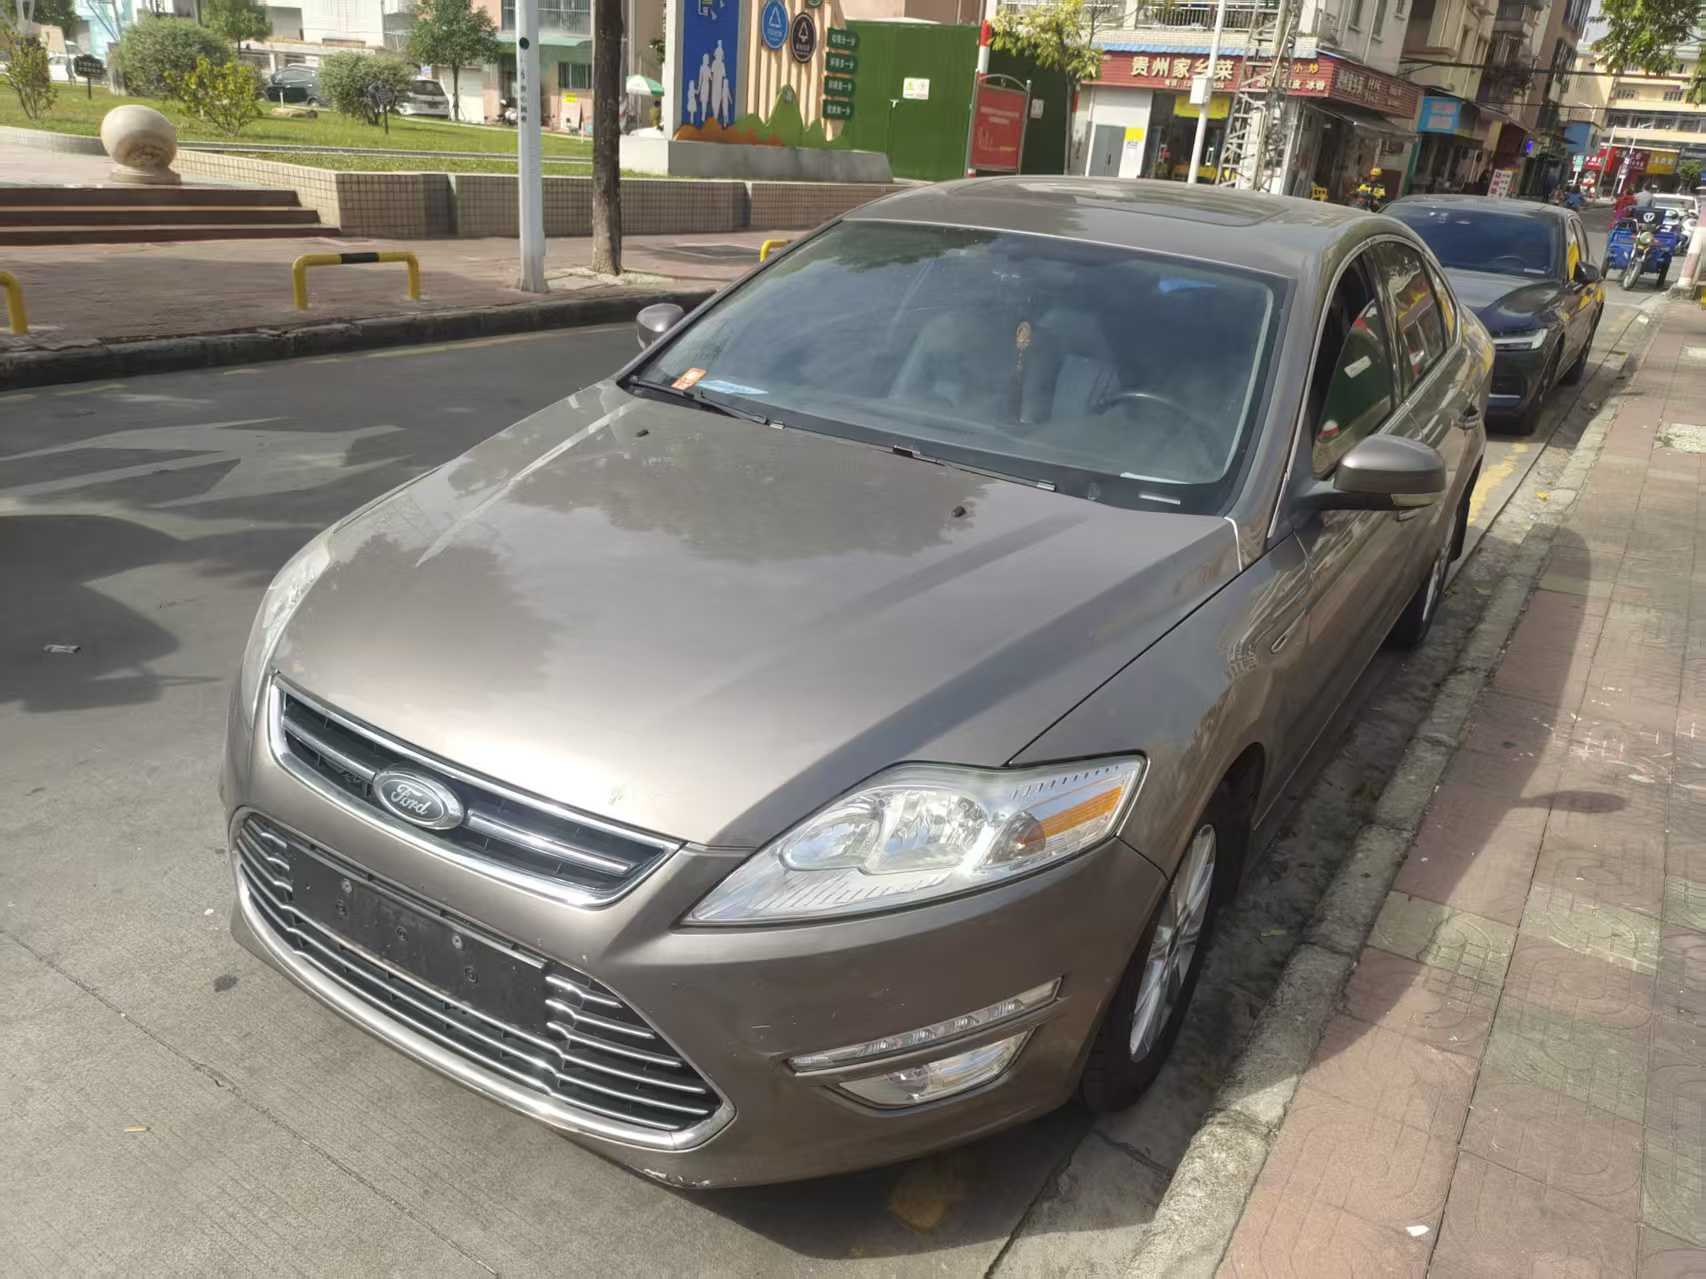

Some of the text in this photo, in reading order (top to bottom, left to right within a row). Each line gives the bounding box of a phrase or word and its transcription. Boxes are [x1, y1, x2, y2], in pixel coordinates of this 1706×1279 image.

[1130, 56, 1234, 80] 贵州家乡菜
[390, 783, 432, 815] Ford
